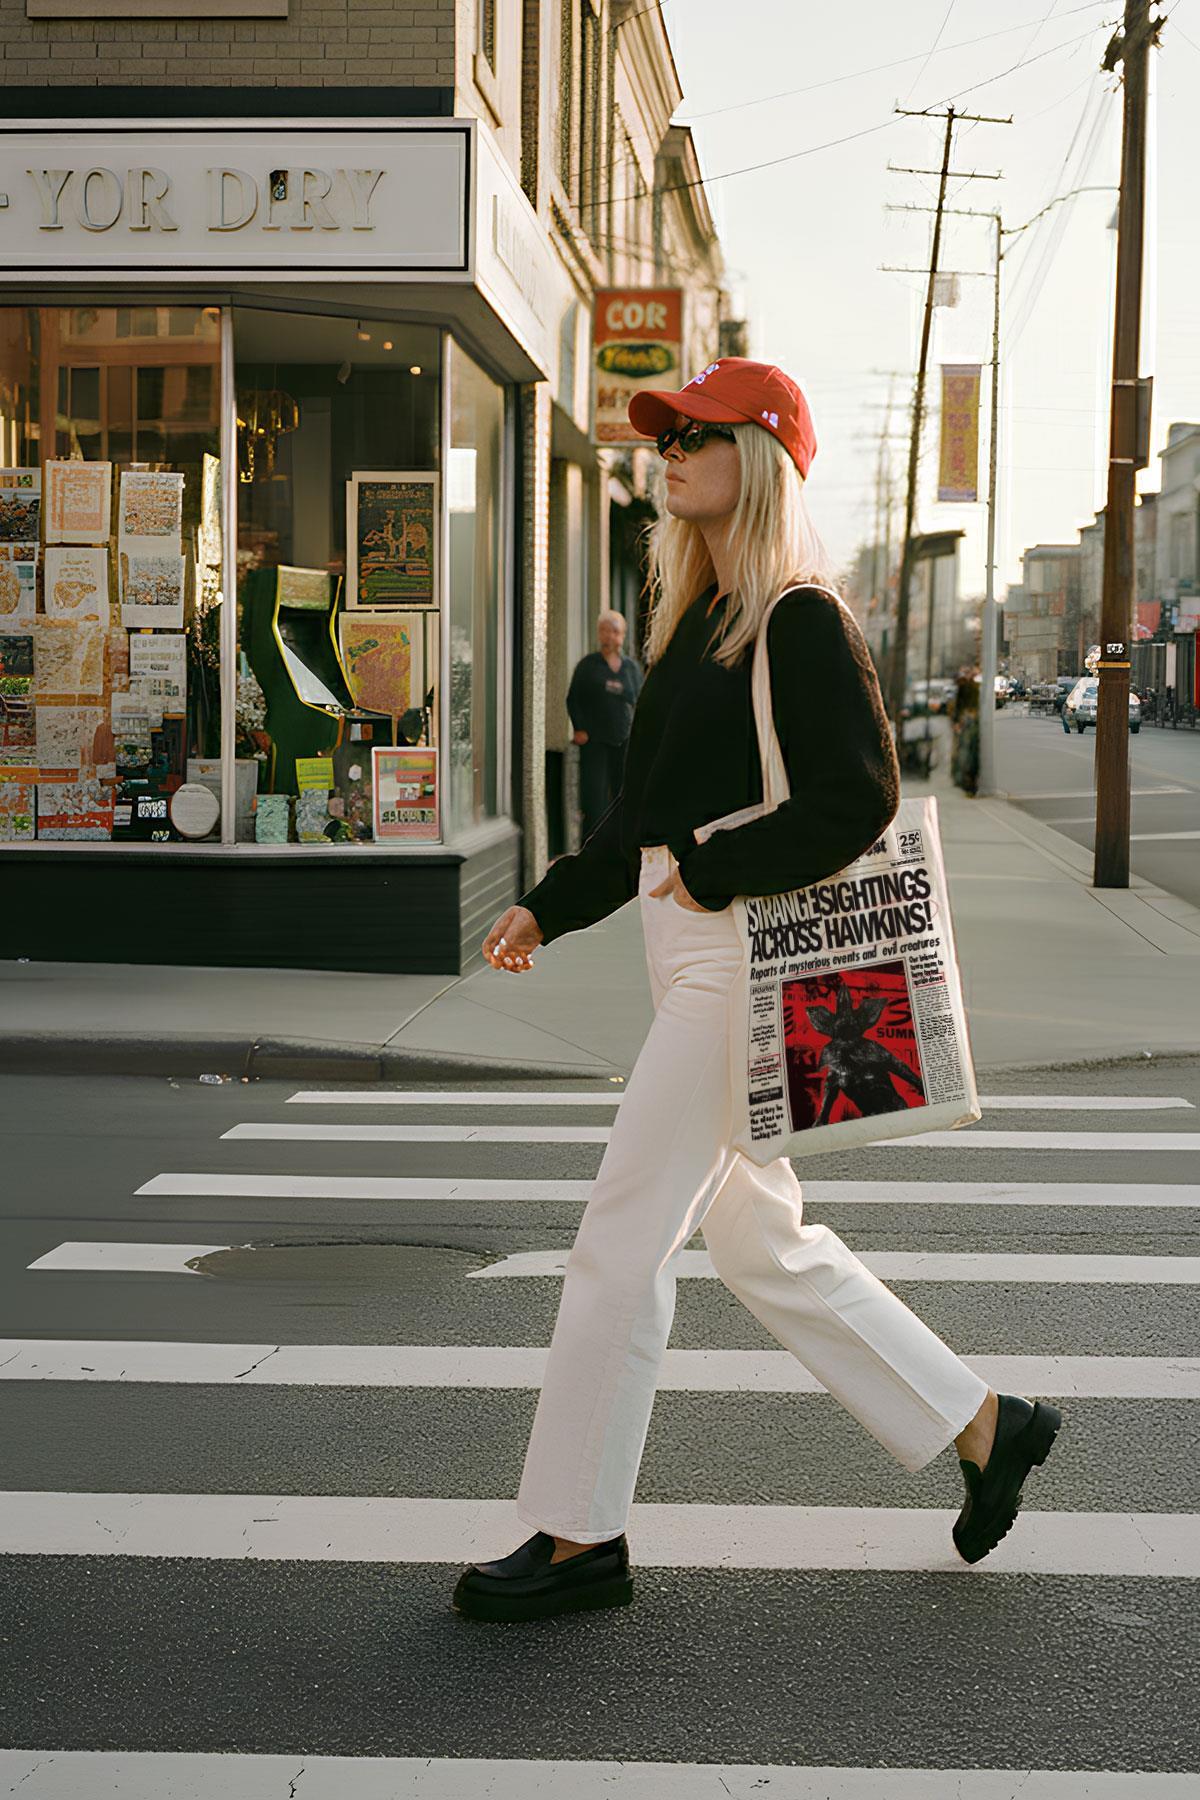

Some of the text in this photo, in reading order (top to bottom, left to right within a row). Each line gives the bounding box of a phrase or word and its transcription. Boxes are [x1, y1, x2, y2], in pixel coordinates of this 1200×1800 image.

[25, 167, 179, 232] YOR
[605, 300, 668, 332] COR
[748, 868, 931, 932] STRANGE SIGHTINGS
[750, 901, 934, 963] ACROSS HAWKINS!
[750, 938, 941, 982] Reports of mysterious events and evil creatures
